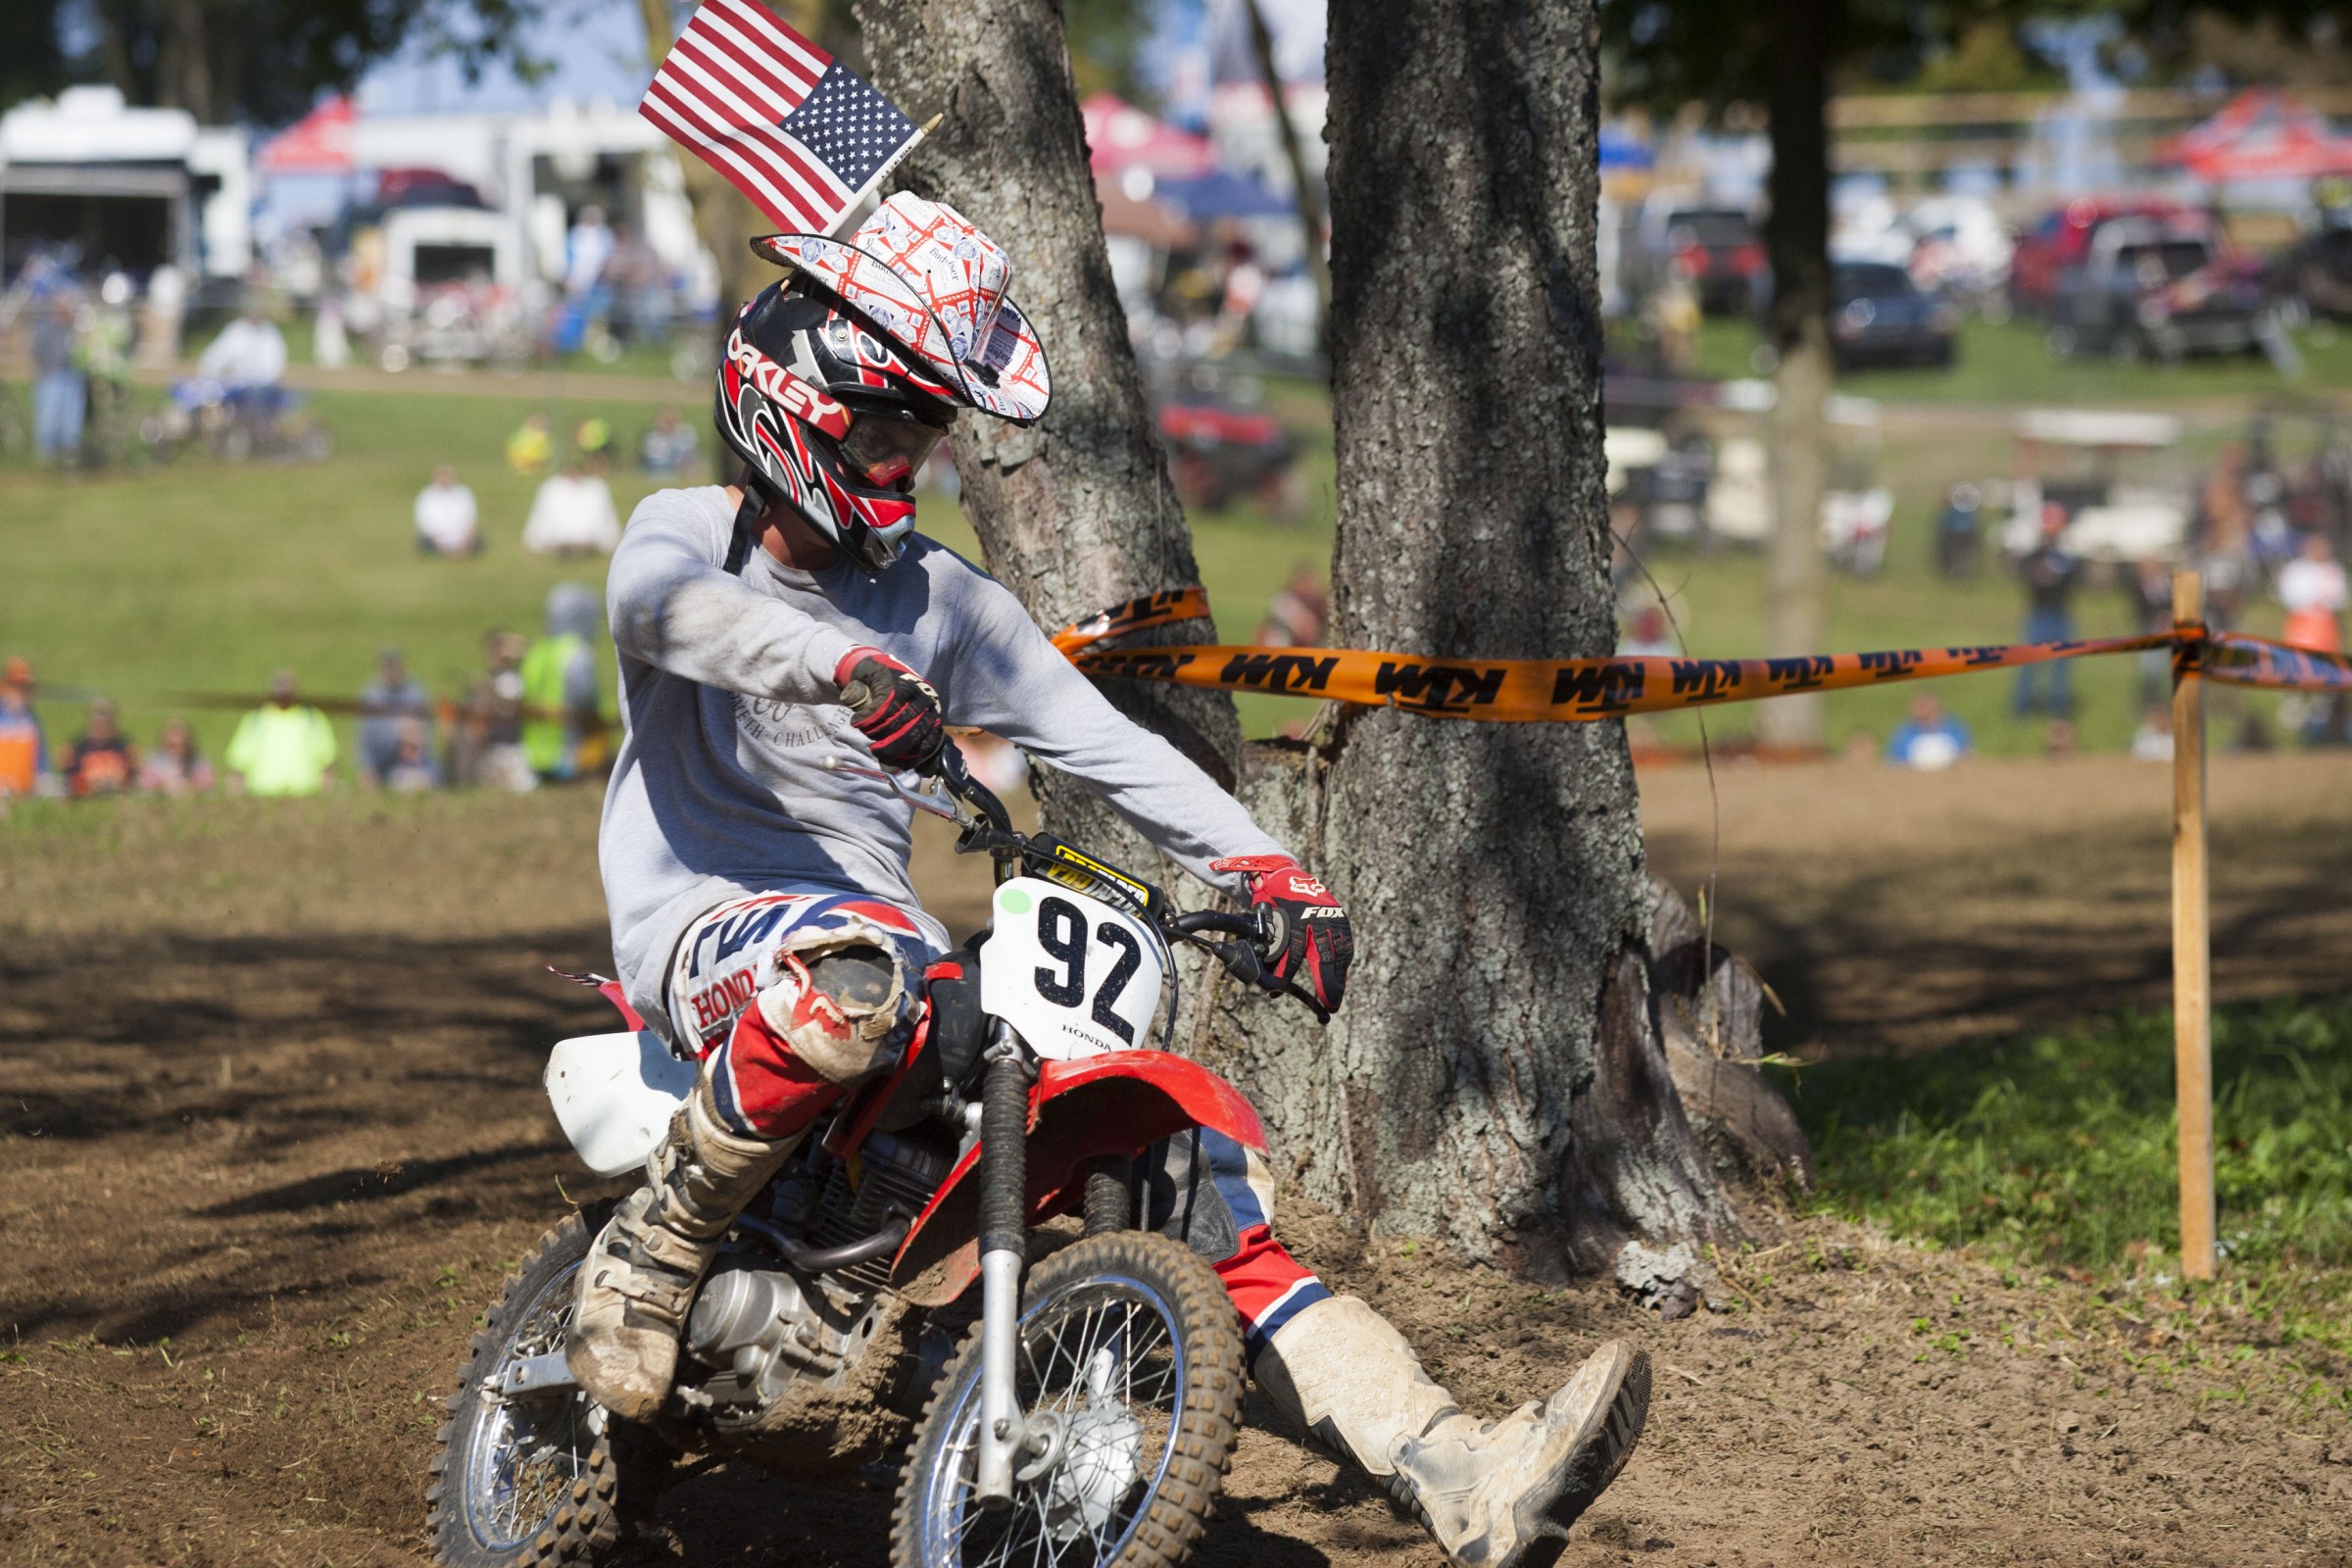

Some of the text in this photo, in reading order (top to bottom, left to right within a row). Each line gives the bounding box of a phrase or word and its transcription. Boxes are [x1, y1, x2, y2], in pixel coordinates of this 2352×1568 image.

[727, 327, 843, 425] OAKLEY
[1375, 662, 1507, 713] KTM
[1550, 662, 1645, 714] KTM
[1670, 660, 1742, 703] KTM
[1766, 655, 1834, 690] KTM
[1299, 906, 1346, 920] FOX
[691, 963, 759, 1029] HOND
[1034, 896, 1142, 1048] 92
[1061, 1024, 1112, 1054] HONDA
